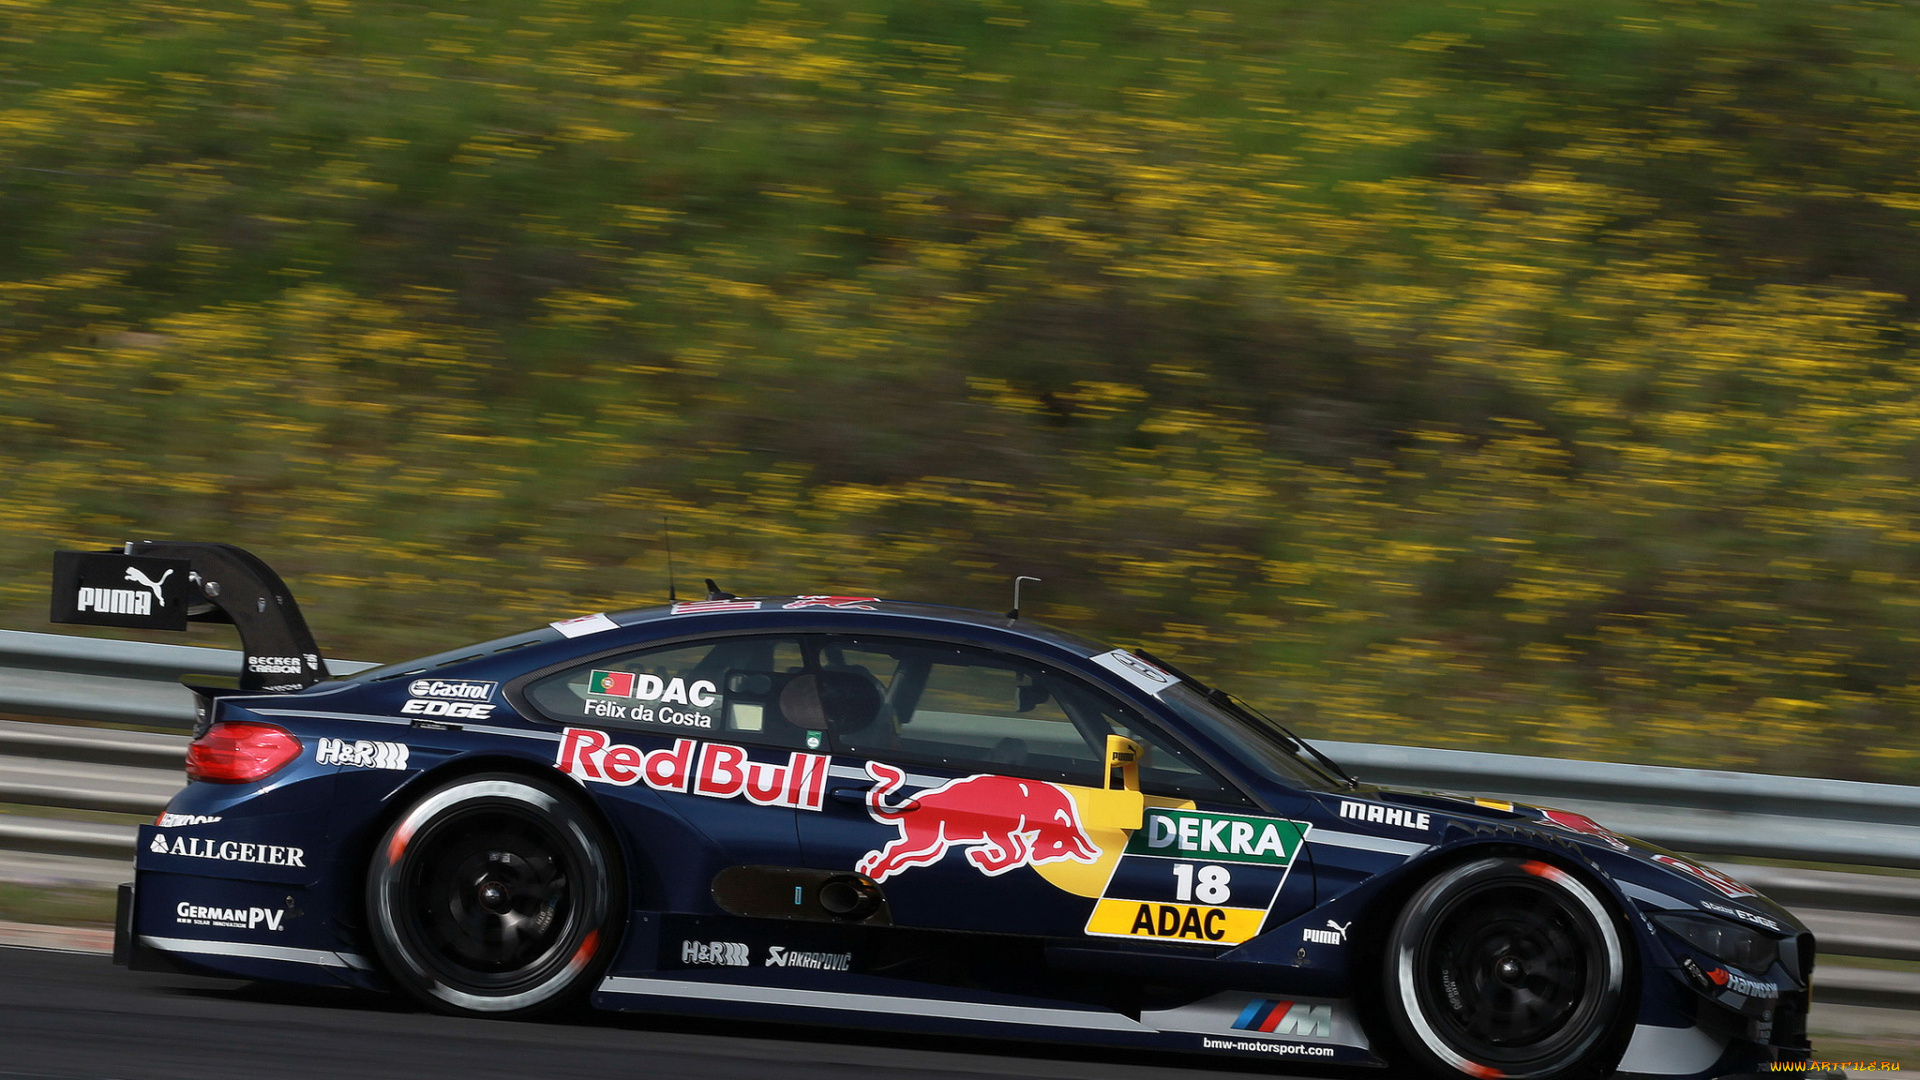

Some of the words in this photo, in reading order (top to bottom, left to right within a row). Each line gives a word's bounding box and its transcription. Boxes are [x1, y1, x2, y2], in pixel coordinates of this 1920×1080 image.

[248, 656, 301, 666] BECKER
[248, 664, 302, 674] CARBON
[429, 681, 491, 699] Castrol
[636, 674, 717, 708] DAC
[401, 699, 497, 720] EDGE
[584, 699, 626, 719] Félix
[631, 705, 654, 721] da
[659, 707, 712, 728] Costa
[316, 737, 382, 769] H&R
[556, 727, 696, 794] Red
[696, 742, 829, 809] Bull
[1340, 801, 1430, 831] MAHLE
[1148, 814, 1287, 859] DEKRA
[169, 836, 307, 868] ALLGEIER
[1173, 863, 1231, 904] 18
[1131, 904, 1227, 941] ADAC
[1736, 909, 1780, 931] EDGE
[682, 939, 728, 966] H&R
[1203, 1037, 1334, 1057] bmw-motorsport.com
